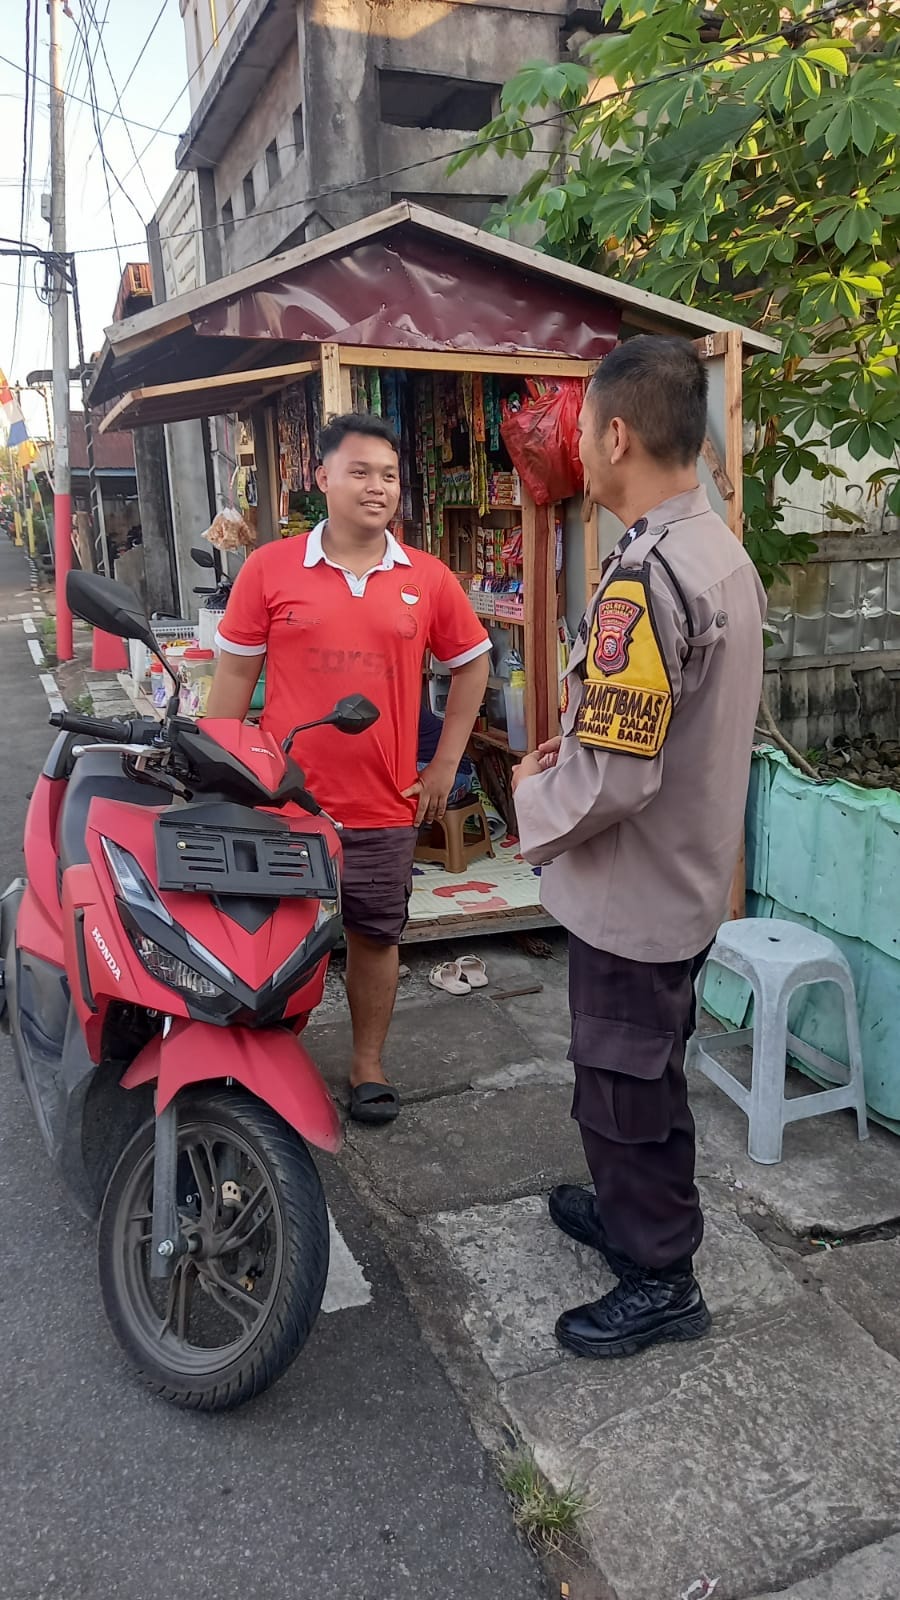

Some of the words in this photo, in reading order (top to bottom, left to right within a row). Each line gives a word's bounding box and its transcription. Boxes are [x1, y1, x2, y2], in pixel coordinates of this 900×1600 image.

[590, 710, 614, 725] JAWI
[617, 729, 655, 746] BARAT
[91, 926, 121, 983] HONDA
